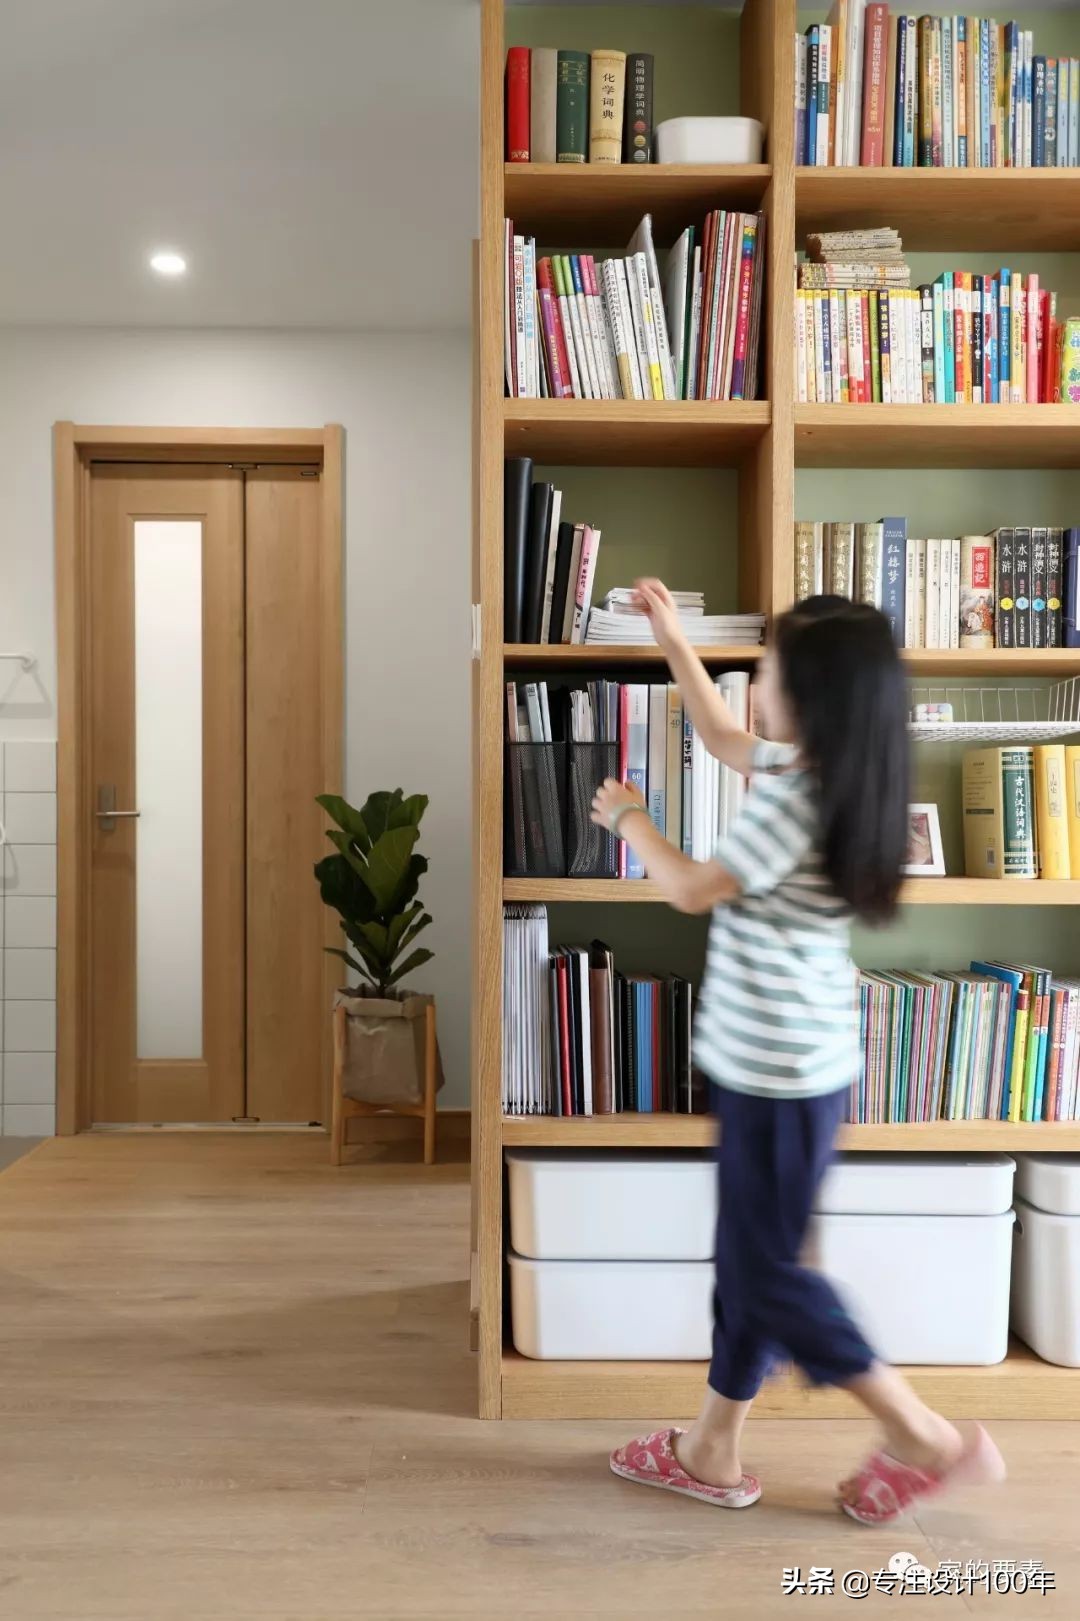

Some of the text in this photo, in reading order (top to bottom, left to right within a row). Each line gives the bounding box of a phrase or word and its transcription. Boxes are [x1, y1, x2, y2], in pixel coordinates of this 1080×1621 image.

[601, 72, 616, 120] 化学词典
[634, 59, 645, 117] 简明物理学词典
[887, 544, 900, 584] 红楼梦
[1001, 543, 1012, 573] 水浒
[1016, 543, 1028, 573] 水浒
[1033, 543, 1045, 575] 封神演义
[1047, 543, 1060, 574] 封神演义
[631, 772, 642, 781] 60
[1014, 776, 1026, 839] 古代汉语词典
